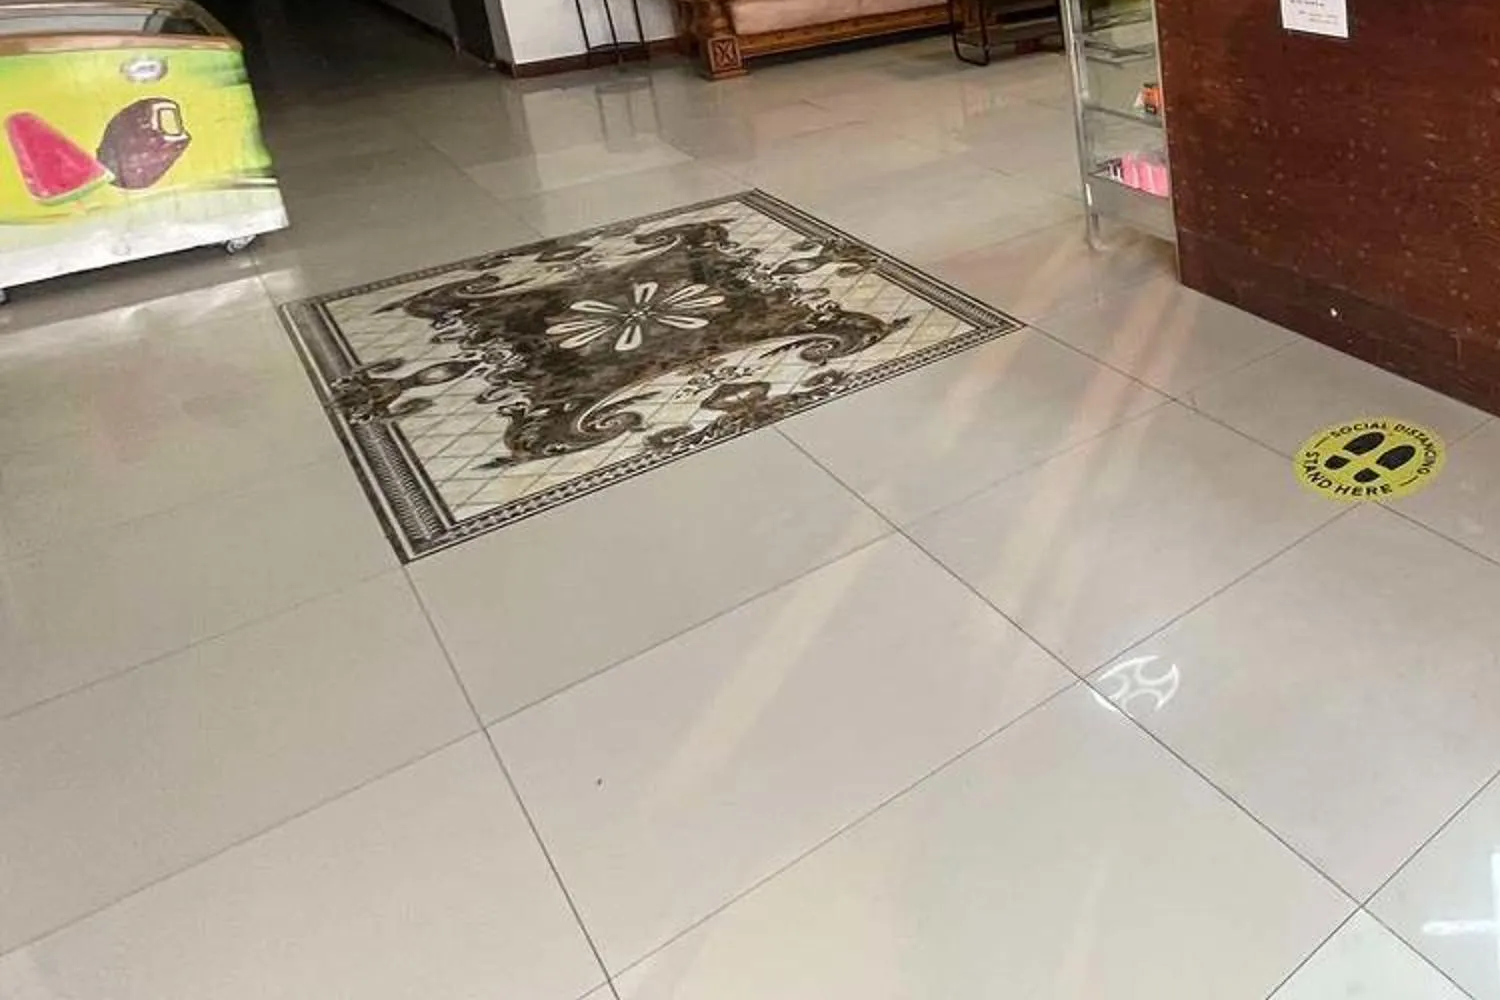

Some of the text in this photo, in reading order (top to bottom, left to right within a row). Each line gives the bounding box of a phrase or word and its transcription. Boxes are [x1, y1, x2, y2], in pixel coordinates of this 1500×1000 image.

[1329, 423, 1437, 475] SOCIAL DISTANCING
[1303, 451, 1393, 497] STAND HERE
